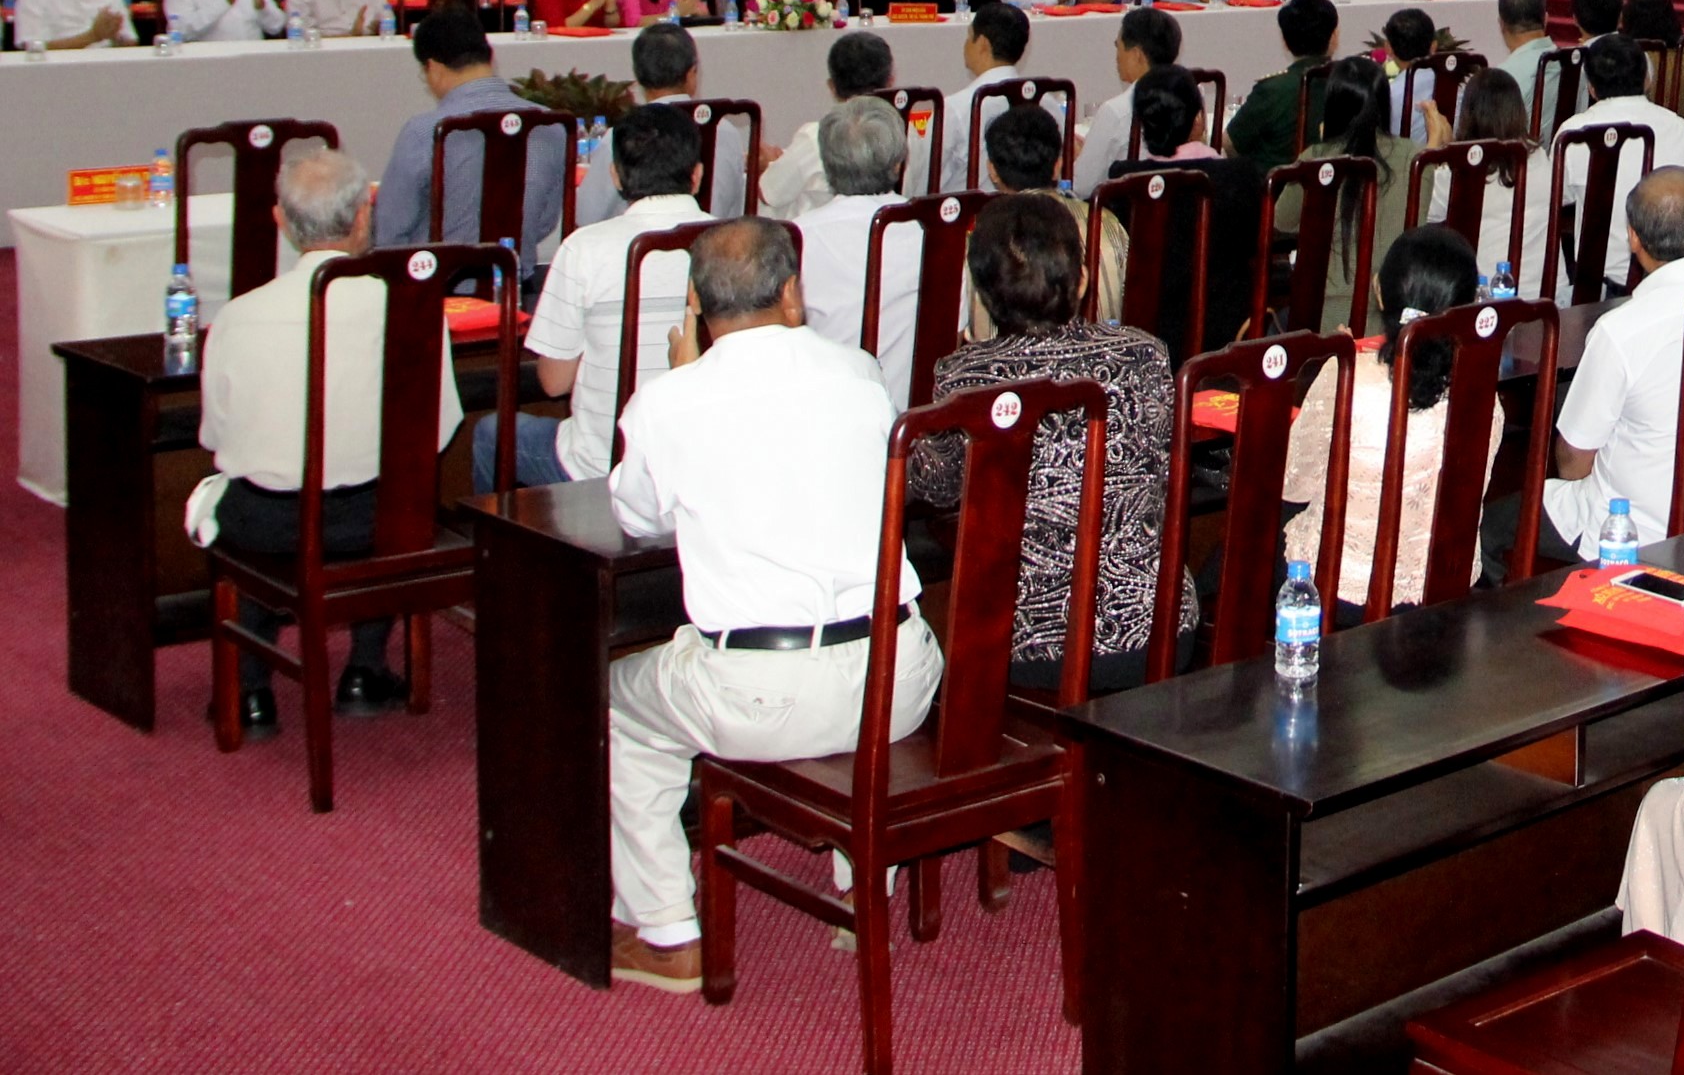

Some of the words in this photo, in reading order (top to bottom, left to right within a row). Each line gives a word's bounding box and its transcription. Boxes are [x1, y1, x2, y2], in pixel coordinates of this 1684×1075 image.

[943, 202, 960, 216] 225
[412, 259, 434, 272] 244
[1478, 315, 1495, 330] 227
[1266, 353, 1285, 369] 241
[996, 400, 1018, 417] 242
